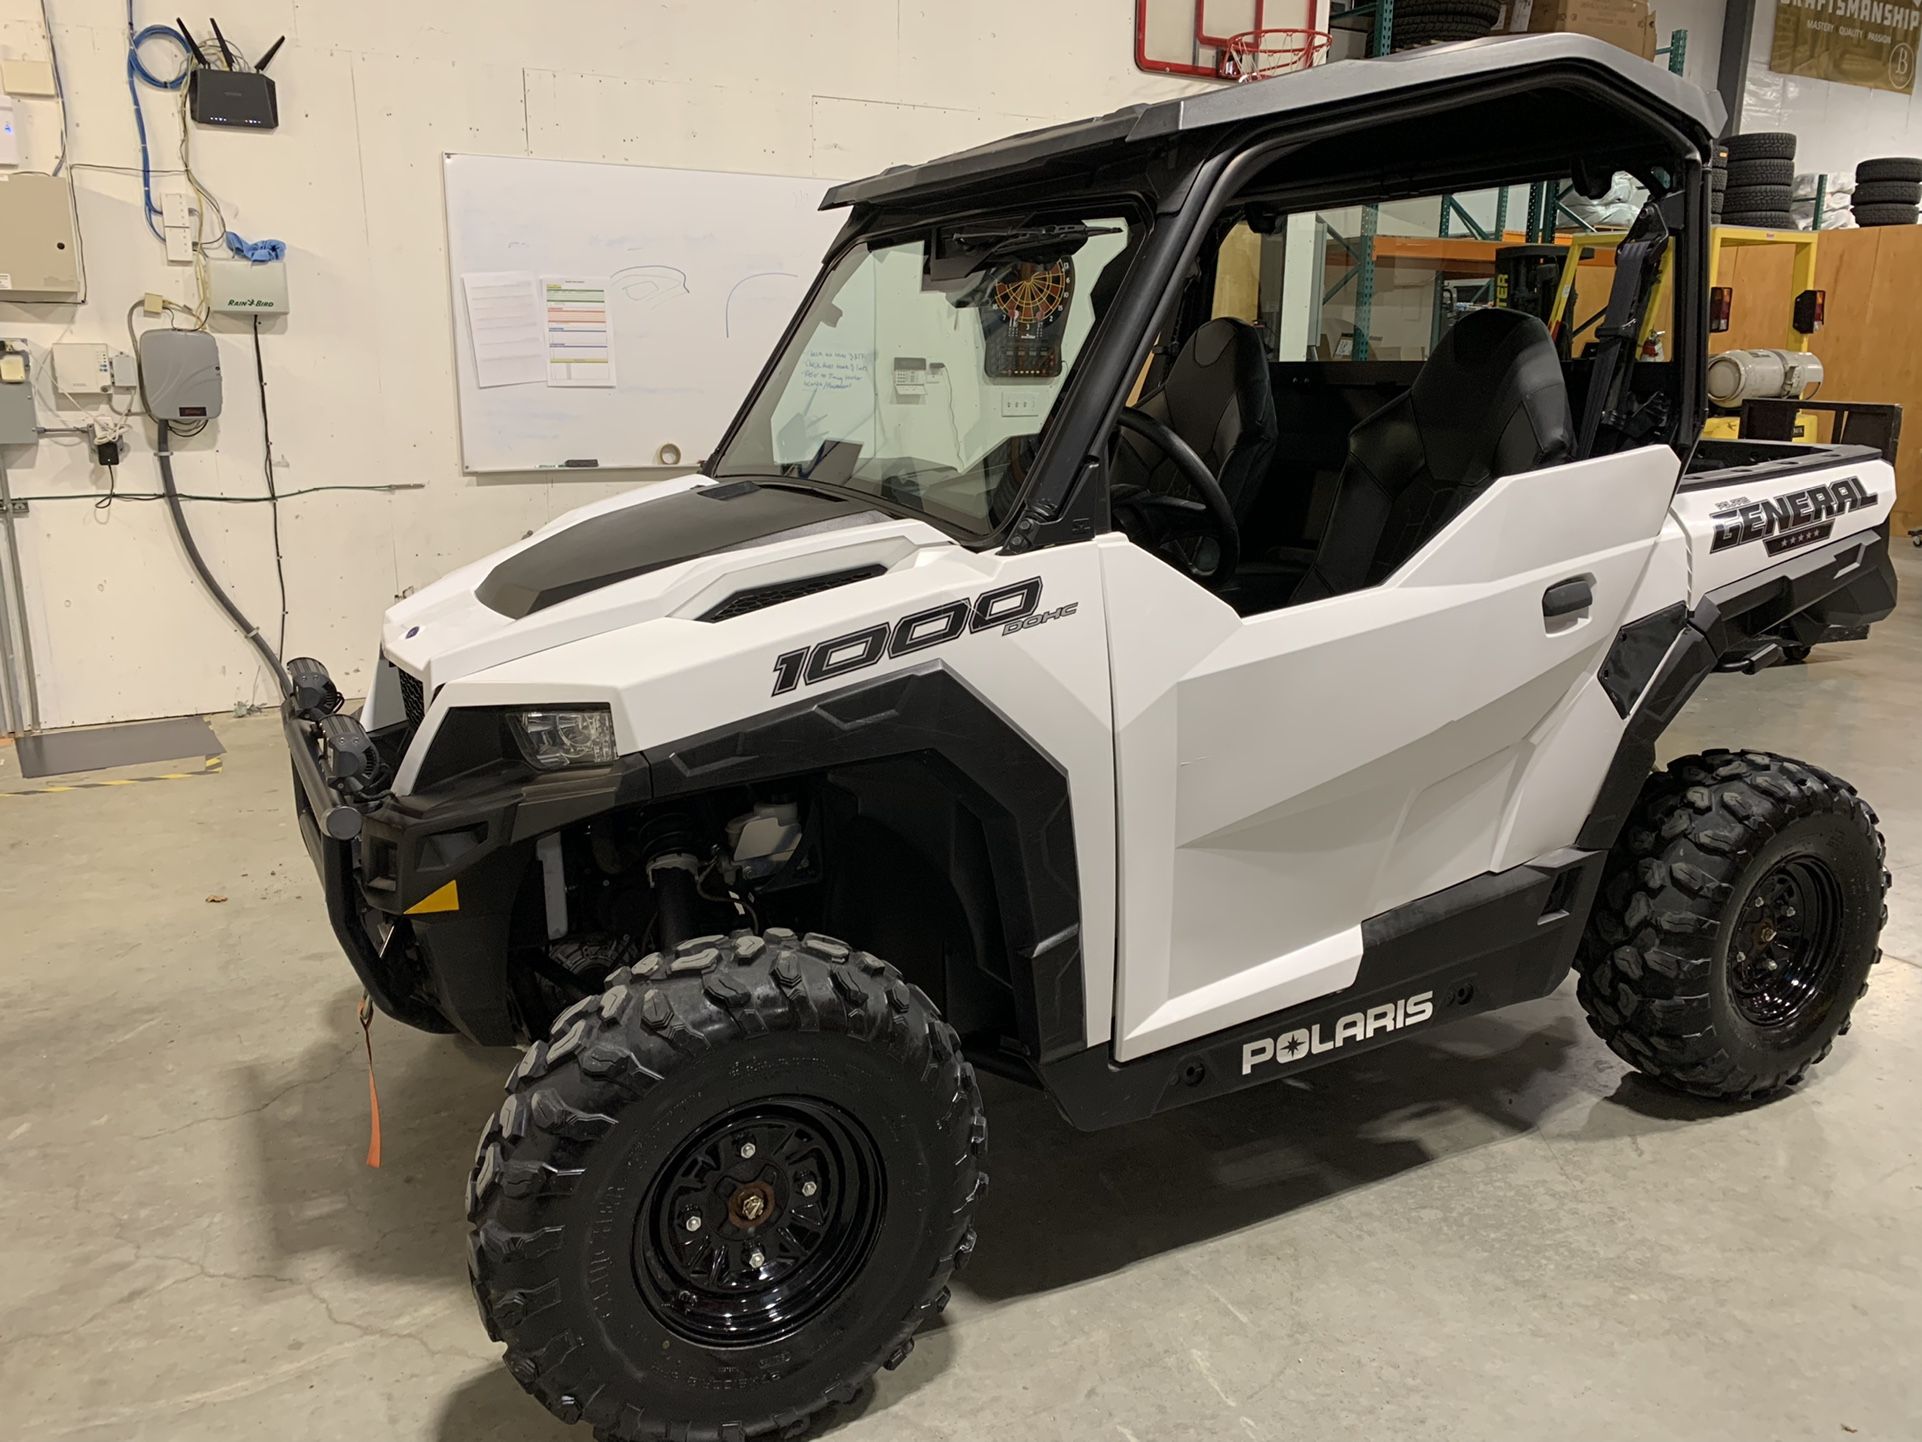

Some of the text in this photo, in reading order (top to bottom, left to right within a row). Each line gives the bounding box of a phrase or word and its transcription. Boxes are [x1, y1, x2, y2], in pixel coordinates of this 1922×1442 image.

[1780, 0, 1920, 31] FTSMANSHIP
[1807, 19, 1834, 32] MASTERY
[1838, 26, 1864, 39] QUALITY
[1709, 475, 1879, 555] GENERAL
[771, 583, 1044, 697] 1000
[1001, 601, 1079, 637] DOHC
[1241, 990, 1434, 1076] POLARIS
